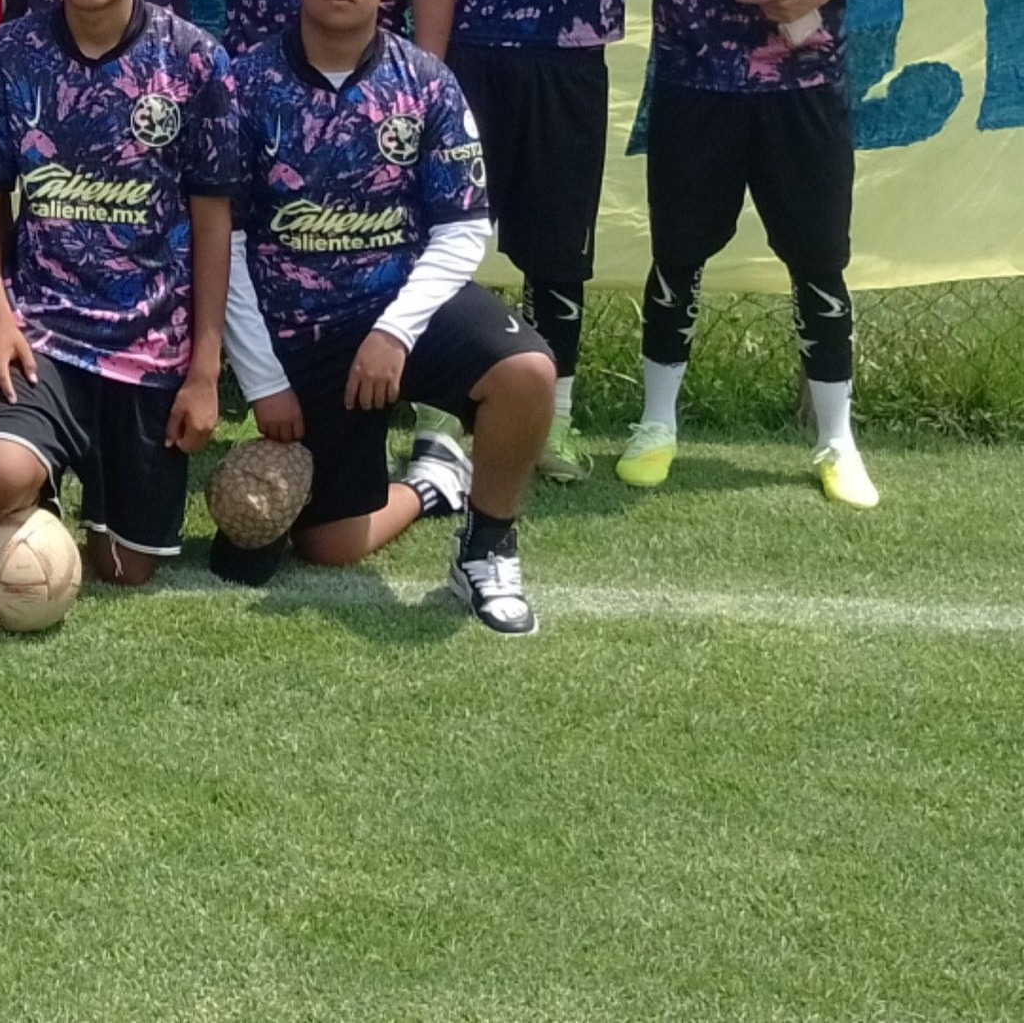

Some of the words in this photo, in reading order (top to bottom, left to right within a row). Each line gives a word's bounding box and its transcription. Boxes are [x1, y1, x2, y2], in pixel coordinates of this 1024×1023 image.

[19, 162, 153, 206] Caliente
[270, 198, 408, 234] Caliente
[278, 229, 406, 252] caliente.mx
